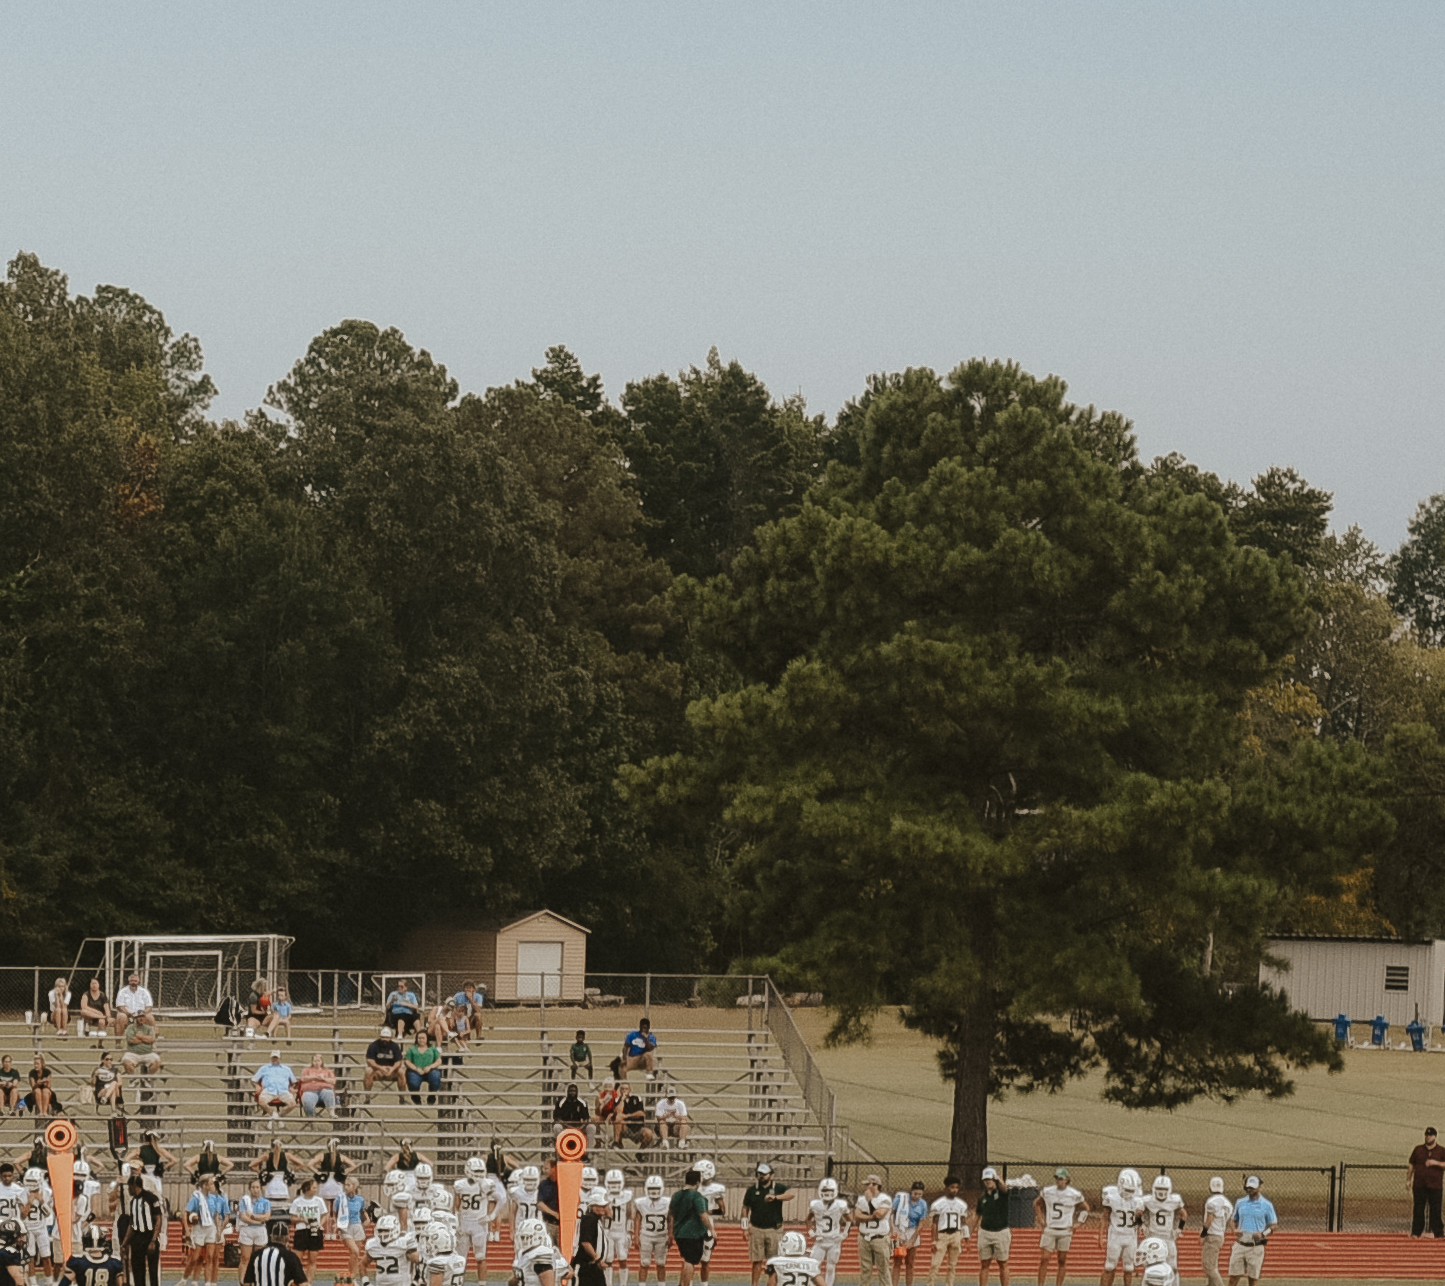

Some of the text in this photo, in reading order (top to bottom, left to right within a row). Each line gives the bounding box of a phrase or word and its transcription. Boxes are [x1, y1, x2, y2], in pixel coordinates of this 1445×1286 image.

[461, 1193, 481, 1211] 56
[1051, 1202, 1063, 1220] 5
[645, 1214, 667, 1233] 53
[822, 1215, 833, 1233] 3
[1116, 1210, 1135, 1228] 33
[1155, 1209, 1166, 1226] 6
[375, 1256, 399, 1275] 52
